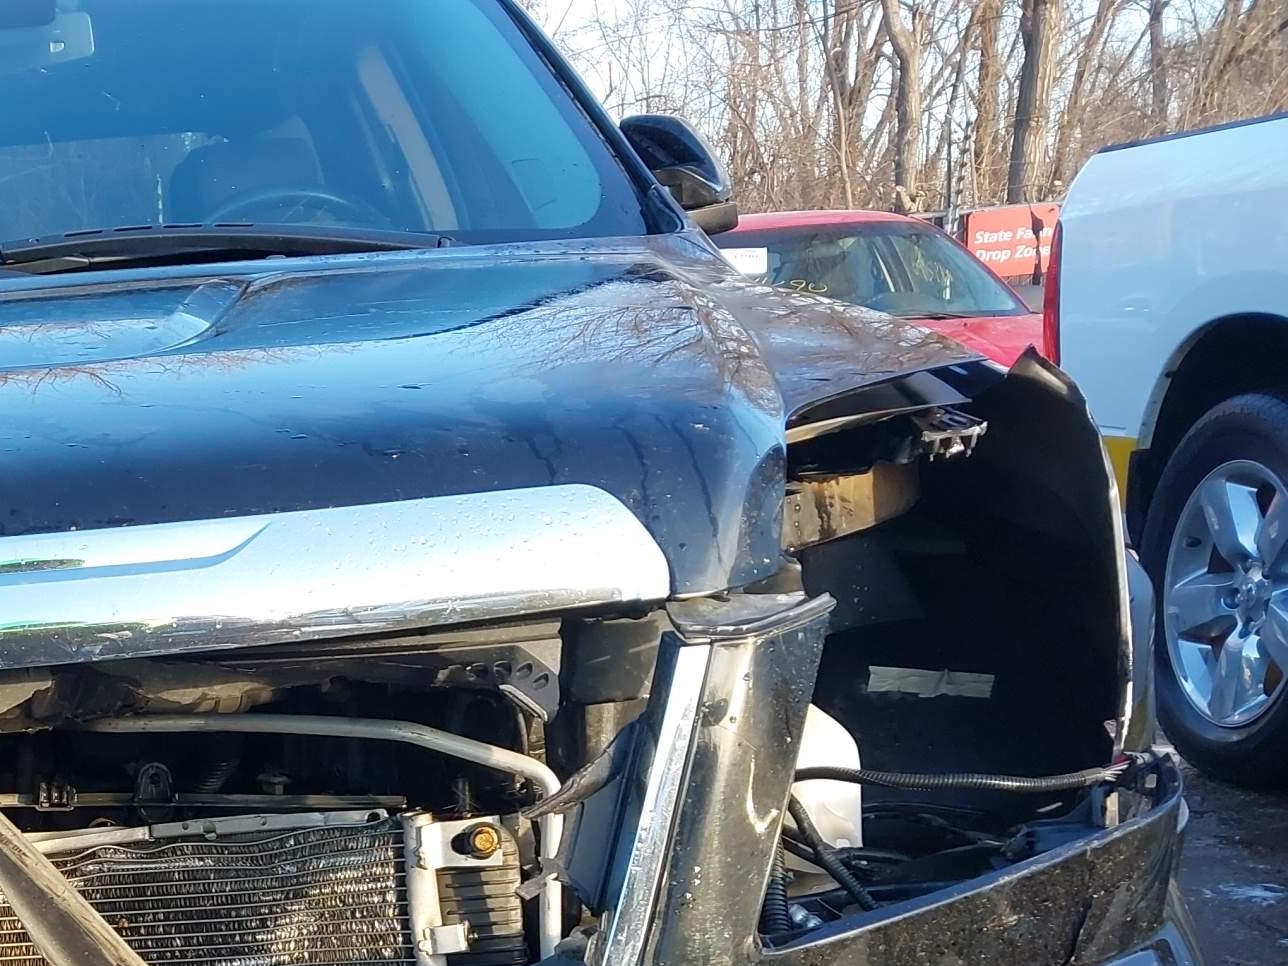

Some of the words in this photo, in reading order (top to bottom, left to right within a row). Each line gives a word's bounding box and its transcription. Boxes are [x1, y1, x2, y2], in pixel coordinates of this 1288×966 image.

[974, 229, 1013, 244] State
[1016, 226, 1053, 240] Fam
[975, 249, 1011, 263] Drop
